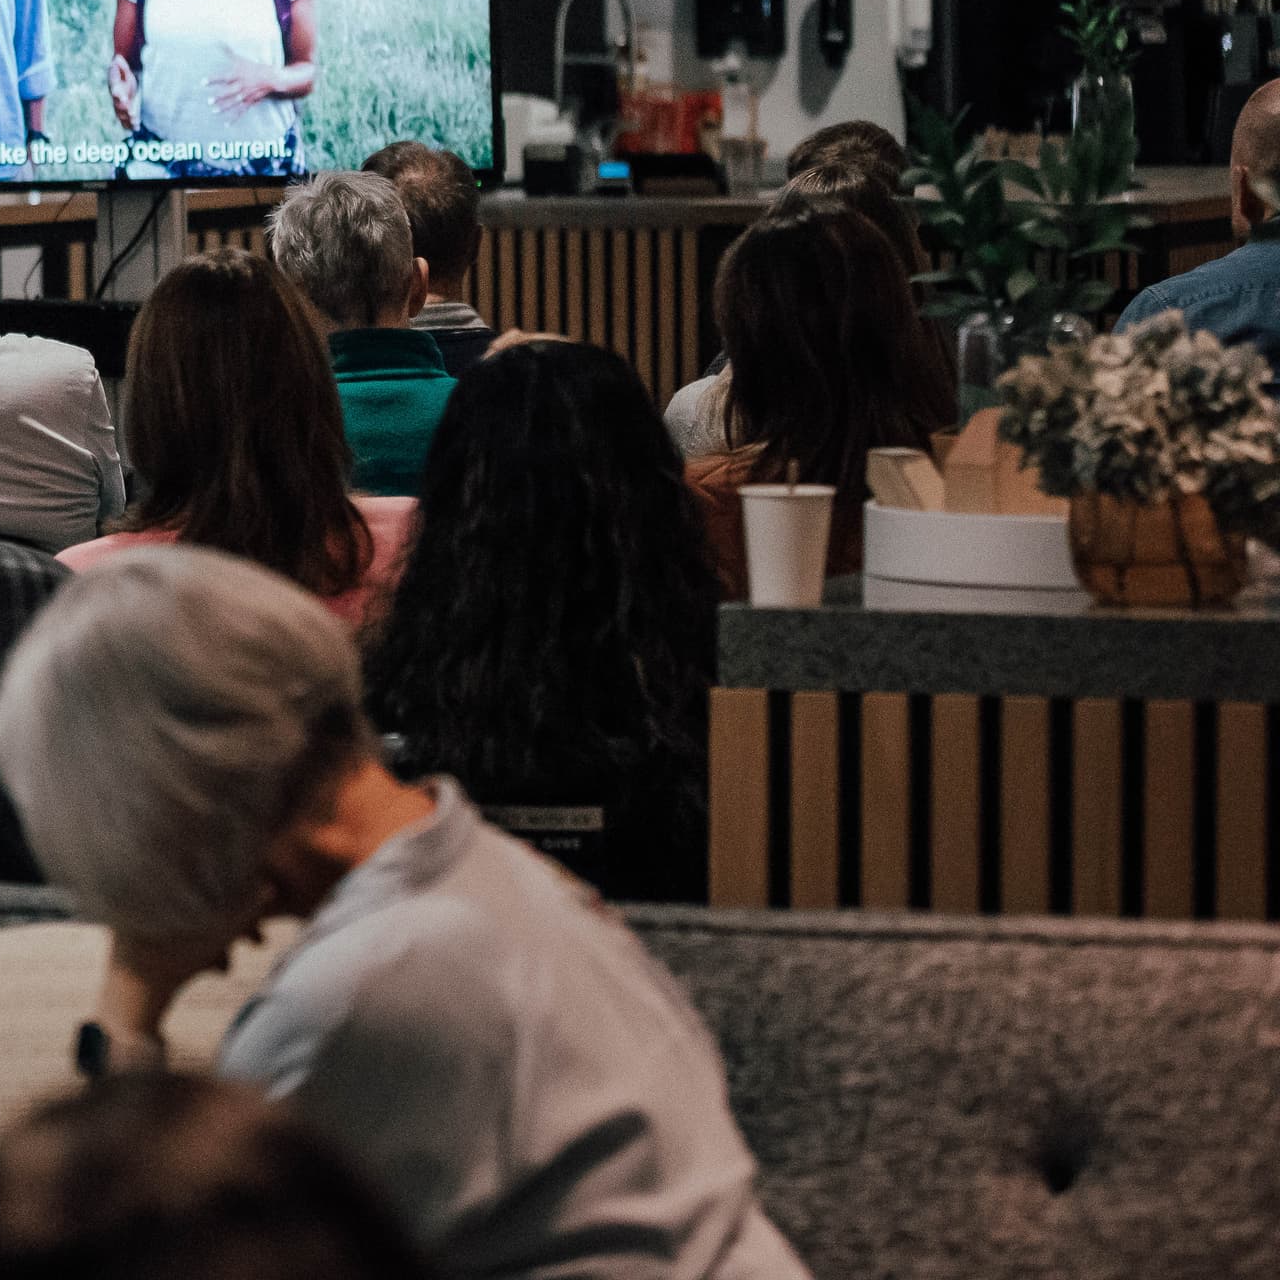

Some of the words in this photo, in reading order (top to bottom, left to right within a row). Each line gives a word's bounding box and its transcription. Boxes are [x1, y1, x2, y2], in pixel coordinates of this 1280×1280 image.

[31, 141, 67, 164] the
[73, 139, 129, 166] deep
[132, 141, 203, 162] ocean
[207, 136, 293, 161] current.
